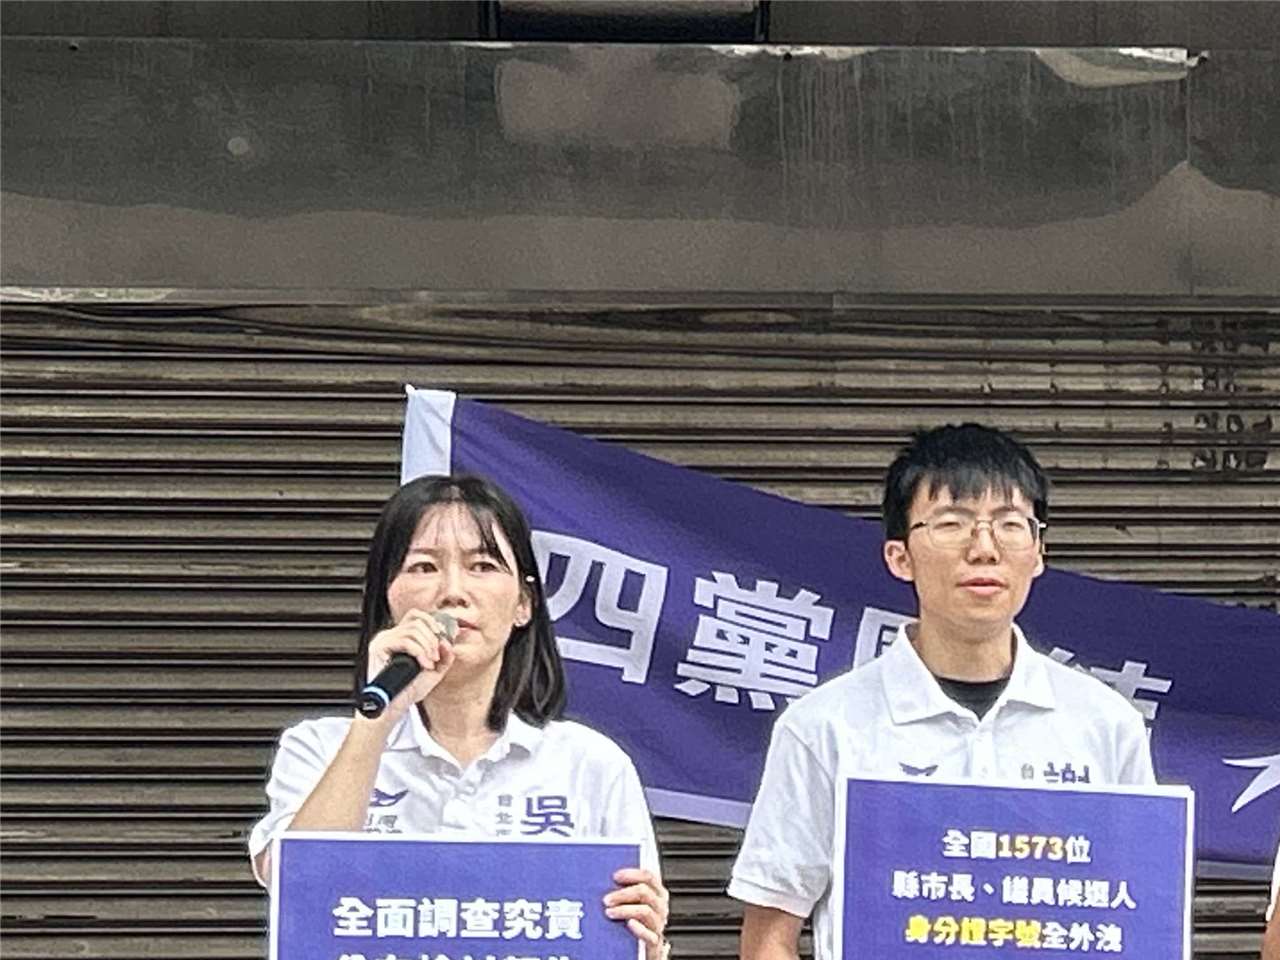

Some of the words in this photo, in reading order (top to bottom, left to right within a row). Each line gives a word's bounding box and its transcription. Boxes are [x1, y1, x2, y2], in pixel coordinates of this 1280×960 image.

[531, 529, 1172, 736] 四黨
[942, 829, 1091, 864] 全國1573位
[331, 896, 585, 940] 全面調查究責
